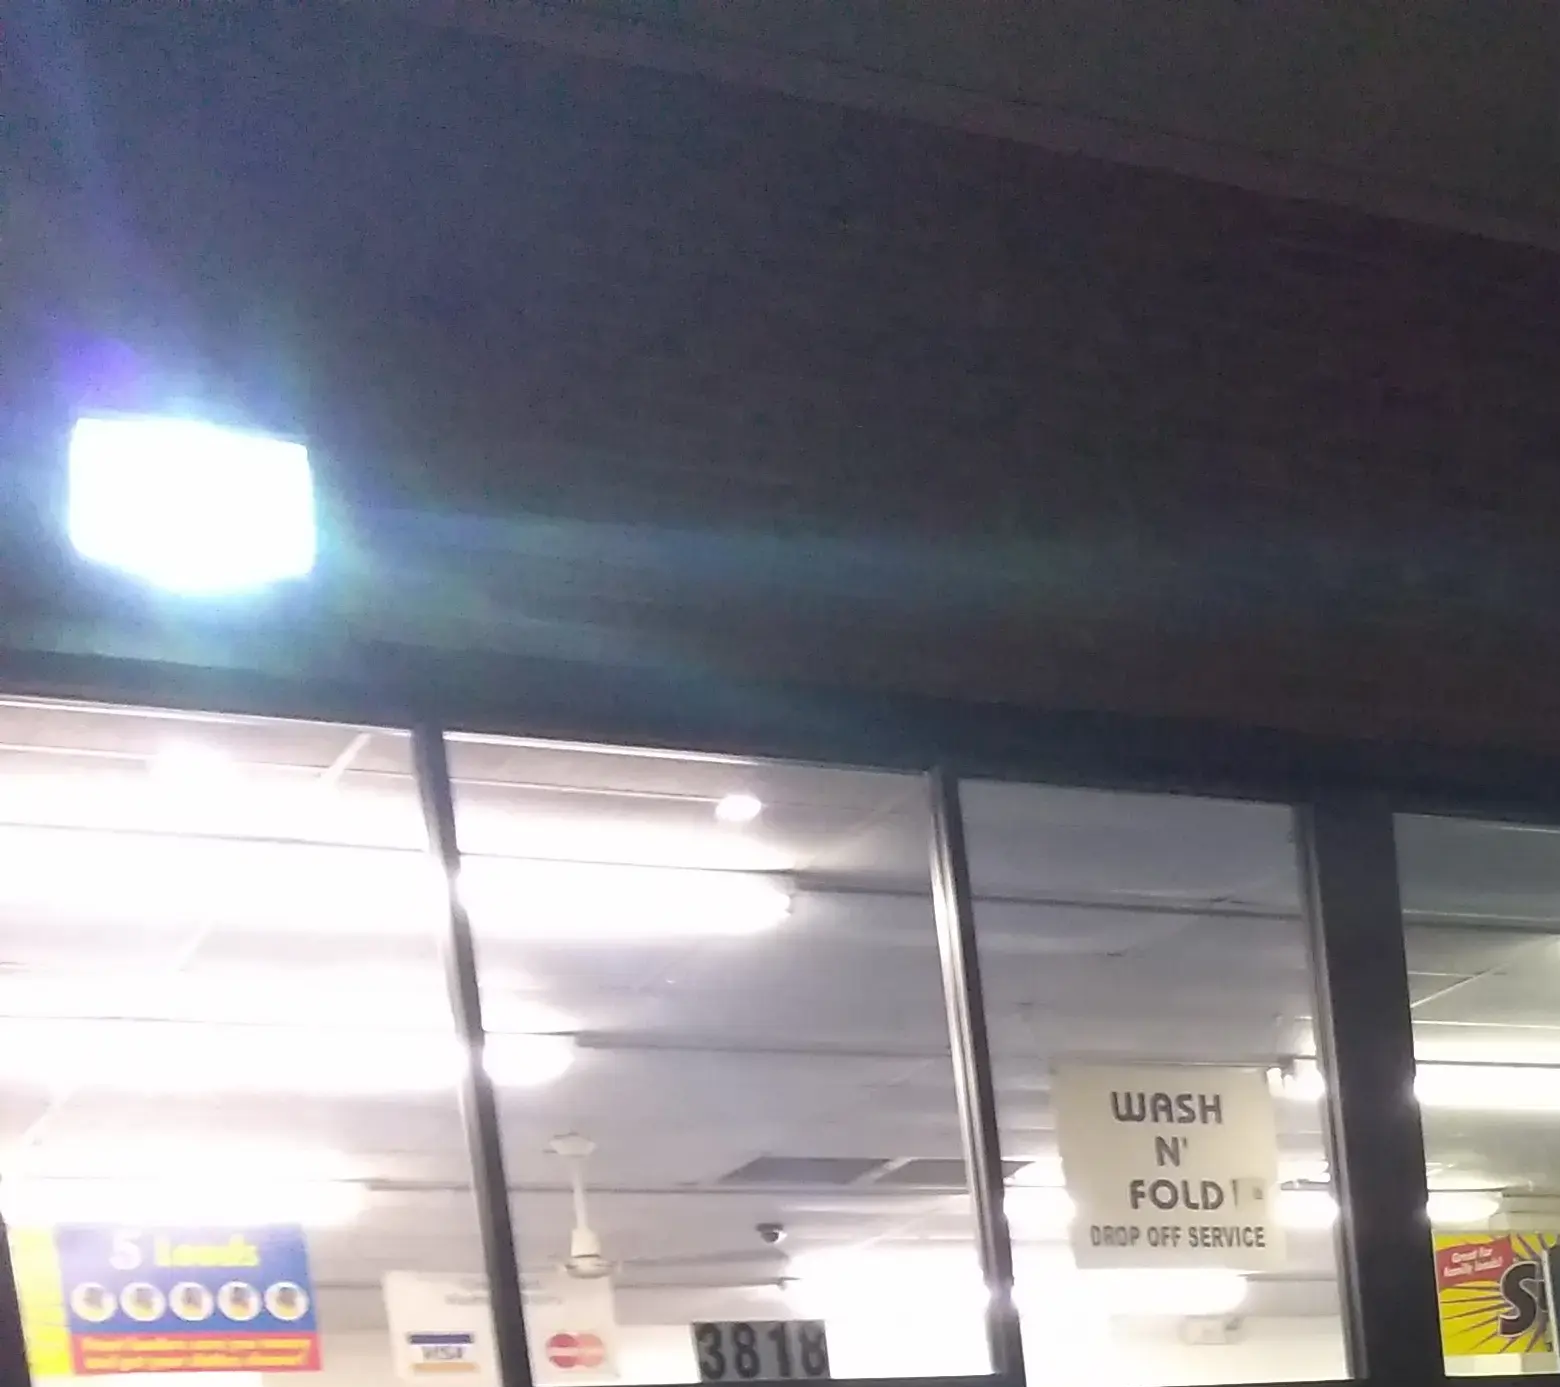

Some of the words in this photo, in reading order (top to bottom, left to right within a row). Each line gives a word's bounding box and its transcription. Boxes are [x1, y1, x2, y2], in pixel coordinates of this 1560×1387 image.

[1110, 1091, 1223, 1124] WASH
[1154, 1136, 1188, 1167] N'
[1129, 1179, 1225, 1211] FOLD
[108, 1229, 143, 1271] 5
[1090, 1225, 1141, 1247] DROP
[1147, 1226, 1181, 1248] OFF
[1188, 1226, 1266, 1248] SERVICE
[695, 1321, 827, 1379] 3818
